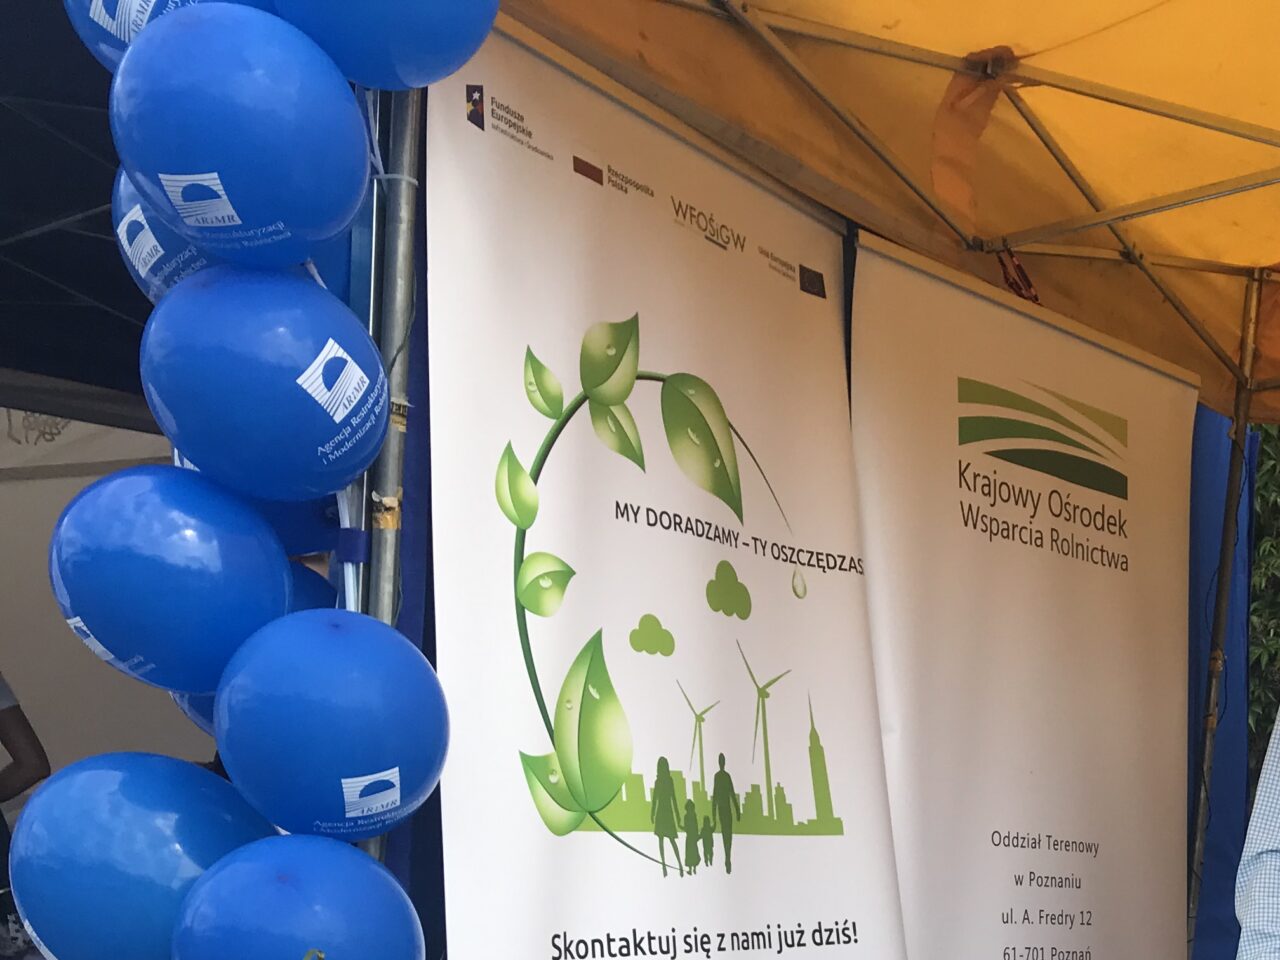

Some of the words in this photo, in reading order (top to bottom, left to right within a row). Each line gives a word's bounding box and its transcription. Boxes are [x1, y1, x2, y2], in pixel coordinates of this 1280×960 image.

[490, 96, 524, 123] Fundusze
[490, 107, 533, 139] Europejskie
[607, 163, 655, 198] Rzeczpospolita
[607, 175, 629, 195] Polska
[341, 375, 367, 415] ARiMR
[317, 425, 352, 456] Agencja
[958, 458, 1042, 519] Krajowy
[1047, 489, 1129, 539] Ośrodek
[614, 500, 642, 524] MY
[646, 507, 740, 549] DORADZAMY
[751, 536, 768, 558] TY
[959, 500, 1044, 543] Wsparcia
[1050, 527, 1129, 572] Rolnictwa
[991, 829, 1042, 850] Oddział
[1045, 834, 1100, 858] Terenowy
[1014, 873, 1024, 887] w
[1028, 871, 1082, 889] Poznaniu
[1001, 907, 1018, 925] ul.
[1021, 908, 1034, 925] A.
[1038, 909, 1076, 930] Fredry
[1079, 911, 1093, 926] 12
[551, 927, 678, 960] Skontaktuj
[683, 926, 712, 959] się
[716, 931, 727, 952] z
[730, 924, 773, 951] nami
[776, 922, 806, 954] już
[811, 918, 859, 947] dziś!
